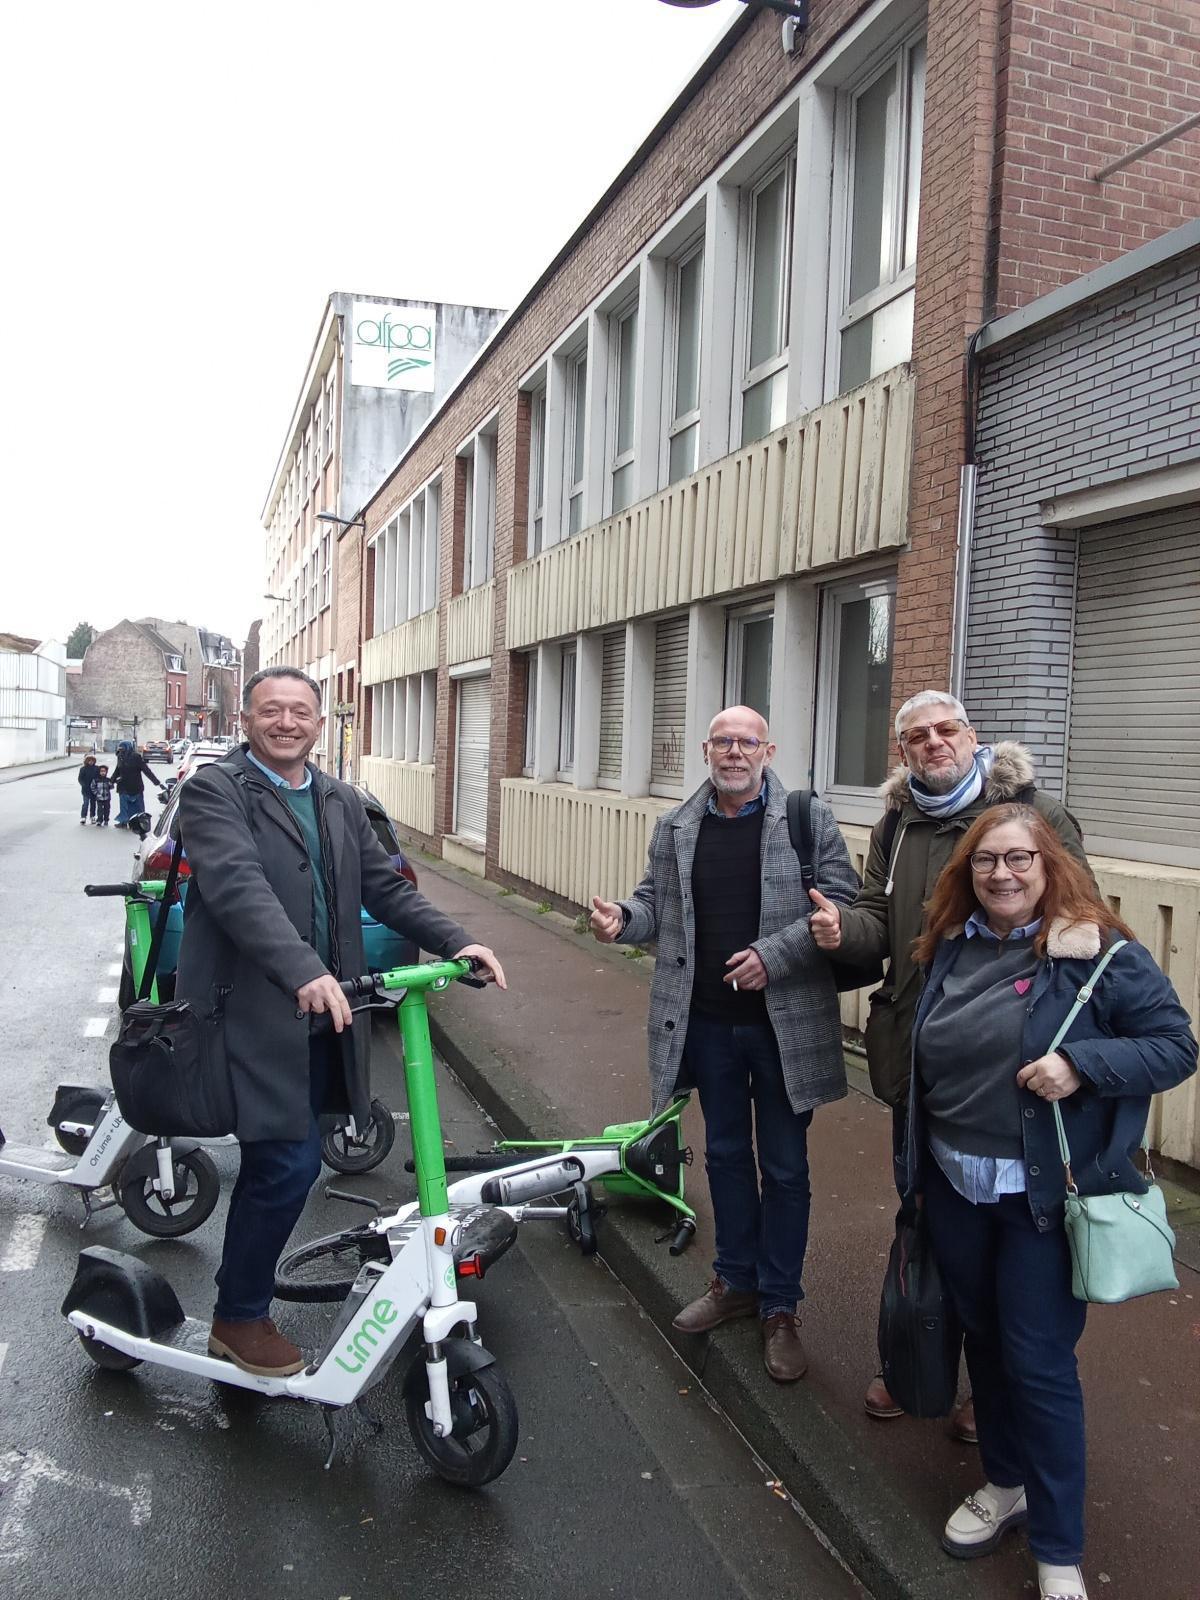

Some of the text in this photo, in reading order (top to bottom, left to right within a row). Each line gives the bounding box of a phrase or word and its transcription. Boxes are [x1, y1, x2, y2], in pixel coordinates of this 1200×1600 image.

[357, 312, 432, 353] afpa
[90, 1154, 100, 1166] On
[97, 1134, 112, 1154] Lime
[112, 1116, 124, 1128] Ub
[334, 1299, 398, 1374] Lime
